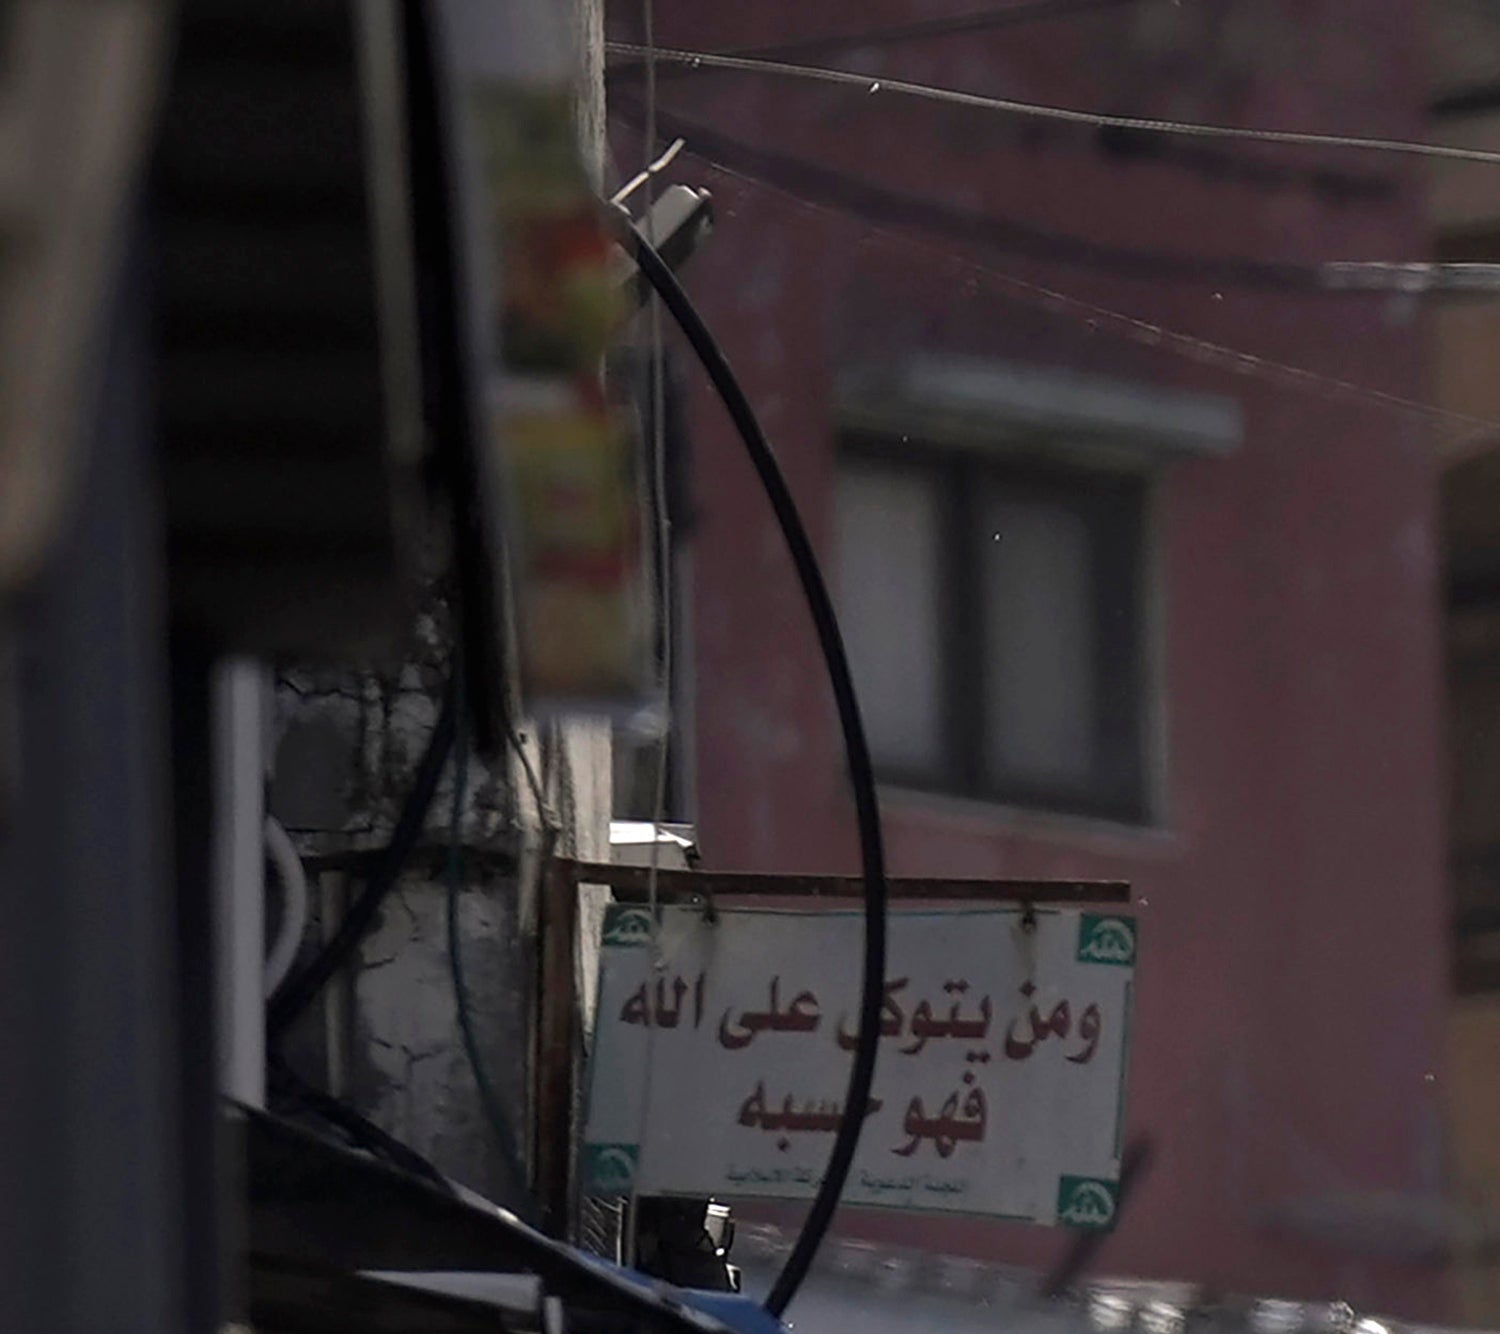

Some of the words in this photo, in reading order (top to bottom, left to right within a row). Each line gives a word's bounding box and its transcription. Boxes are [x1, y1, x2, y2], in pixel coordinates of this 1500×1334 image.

[619, 970, 705, 1031] الله
[718, 976, 821, 1049] على
[1005, 979, 1101, 1063] ومن
[736, 1079, 881, 1153] سبه
[892, 1070, 989, 1160] فهو
